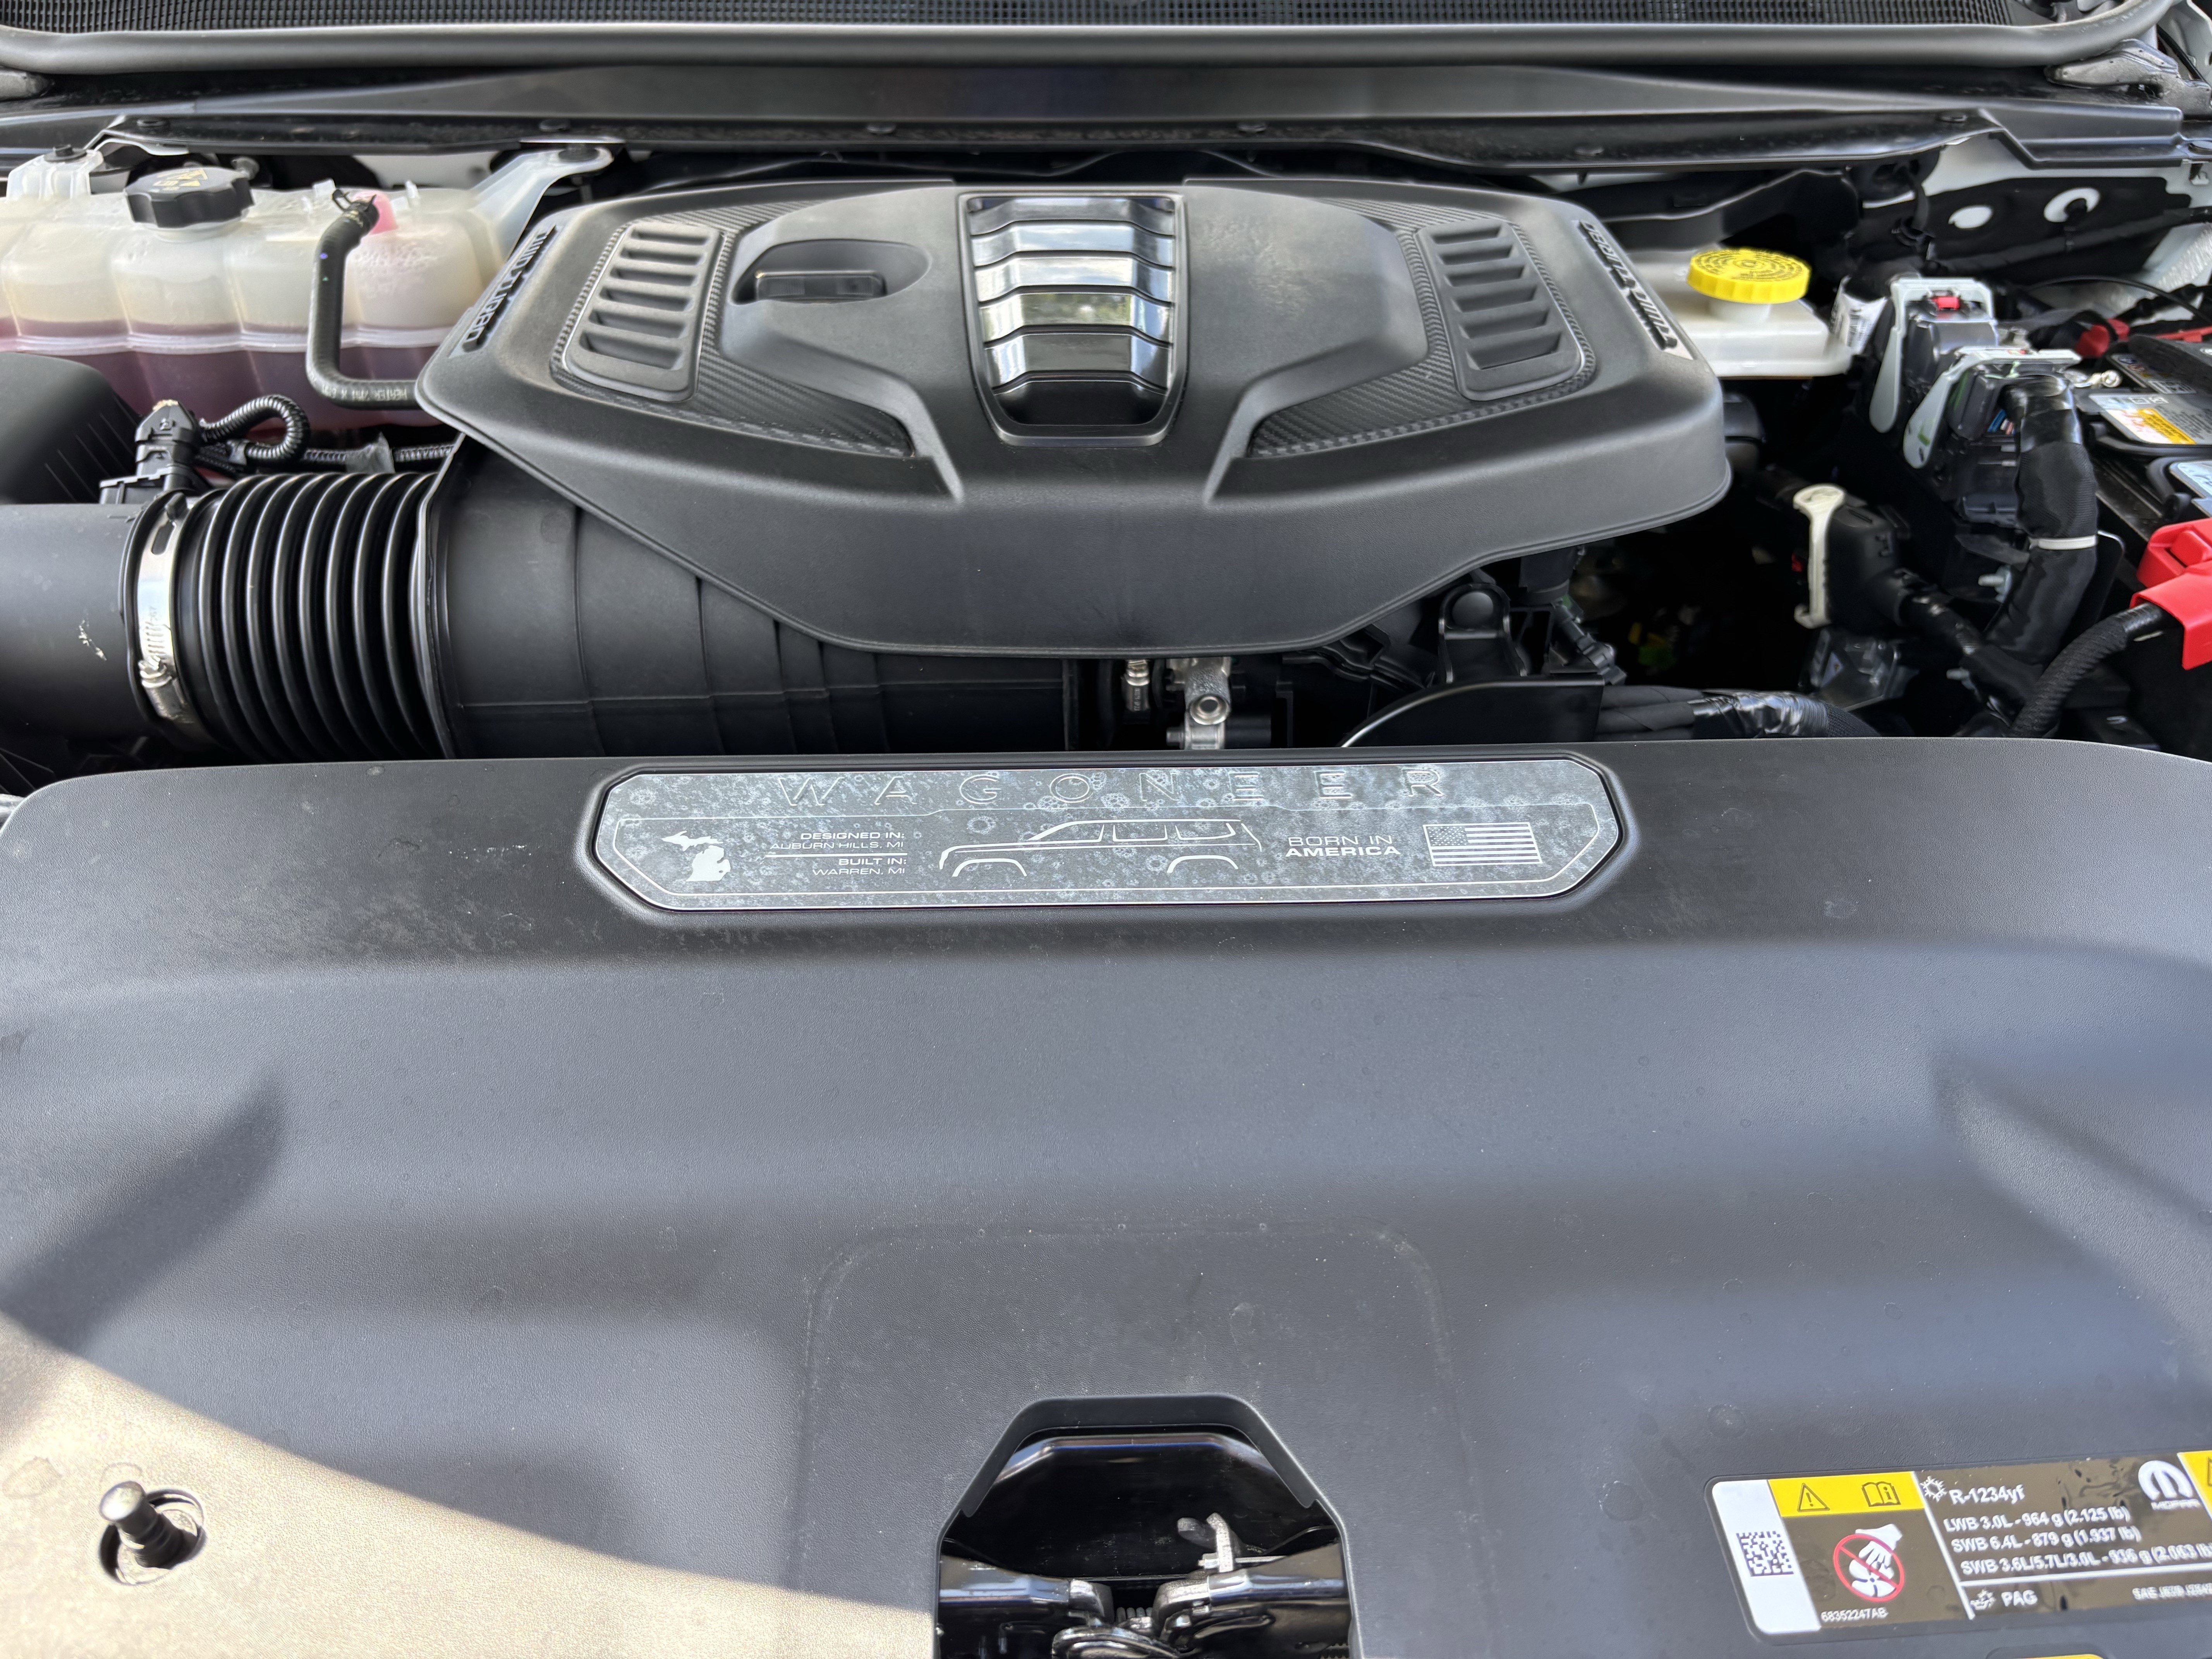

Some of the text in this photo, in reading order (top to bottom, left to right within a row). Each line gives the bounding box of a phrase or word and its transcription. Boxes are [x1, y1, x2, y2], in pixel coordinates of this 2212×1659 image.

[776, 768, 1443, 806] WAGONEER
[1288, 835, 1393, 847] BORN IN
[1285, 846, 1401, 857] AMERICA
[838, 858, 883, 866] BUILT
[1949, 1484, 2025, 1505] R-1234yf
[1943, 1516, 1980, 1532] LWB
[1980, 1515, 2014, 1530] 3.0L
[2021, 1511, 2050, 1527] 964
[2051, 1513, 2064, 1527] g
[1951, 1537, 1989, 1553] SWB
[2031, 1532, 2059, 1547] 879
[2061, 1533, 2075, 1548] g
[1960, 1559, 1999, 1575] SWB
[2138, 1550, 2153, 1565] g
[2001, 1589, 2038, 1607] PAG
[1820, 1607, 1889, 1623] 68352247AB
